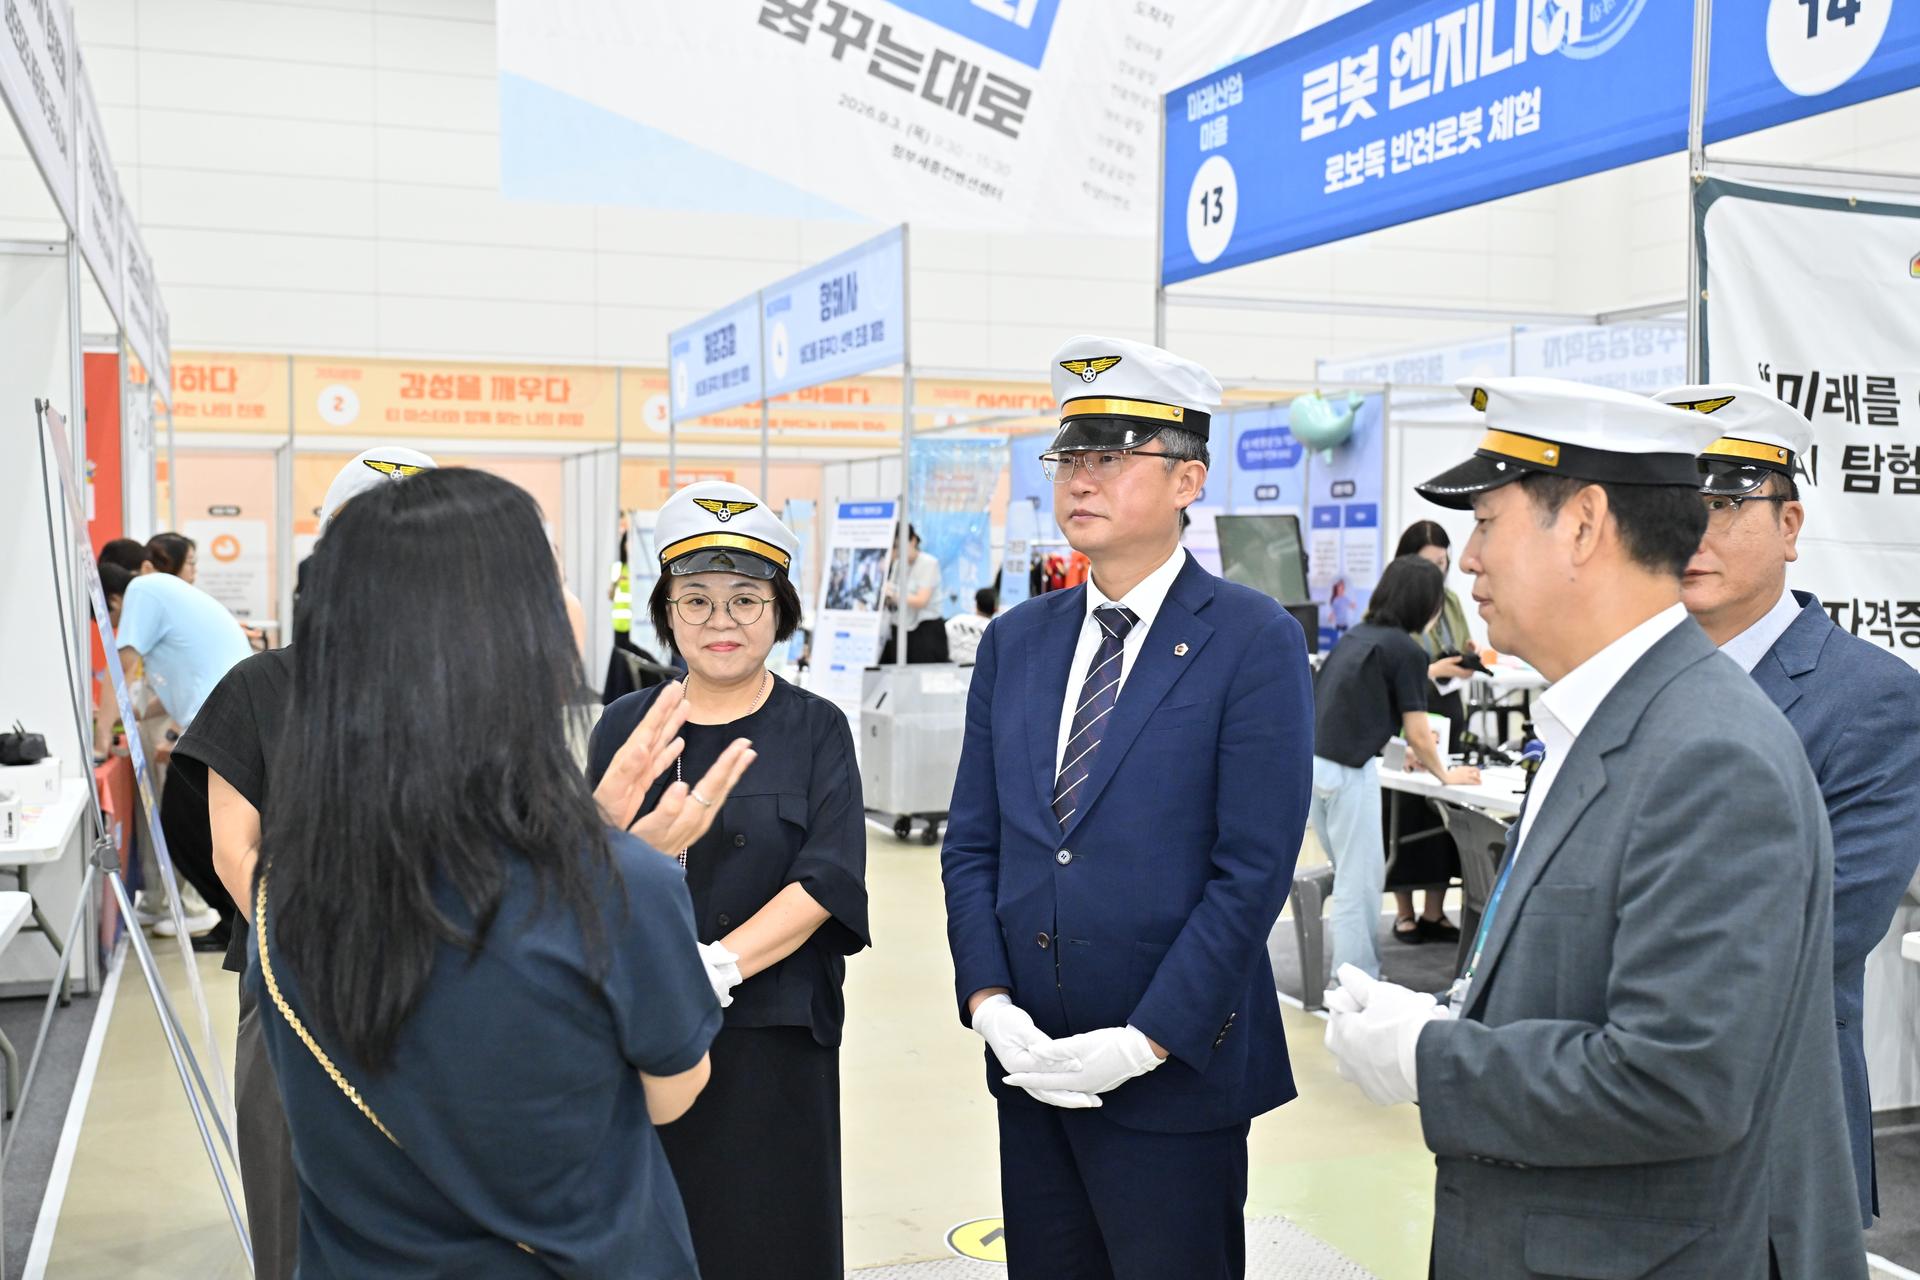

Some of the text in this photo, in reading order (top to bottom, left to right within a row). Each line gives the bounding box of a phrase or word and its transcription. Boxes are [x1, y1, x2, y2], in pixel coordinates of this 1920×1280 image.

[1798, 0, 1861, 39] 14
[1301, 0, 1582, 142] 로봇 엔지니어
[1187, 73, 1244, 122] 미래산업
[1200, 115, 1228, 151] 마을
[1324, 86, 1541, 194] 로보독 반려로봇 체험
[1200, 186, 1223, 227] 13
[170, 366, 238, 394] 하다
[400, 373, 571, 403] 감성을 깨우다
[333, 396, 344, 412] 2
[656, 404, 667, 421] 3
[1841, 444, 1920, 494] 탐험
